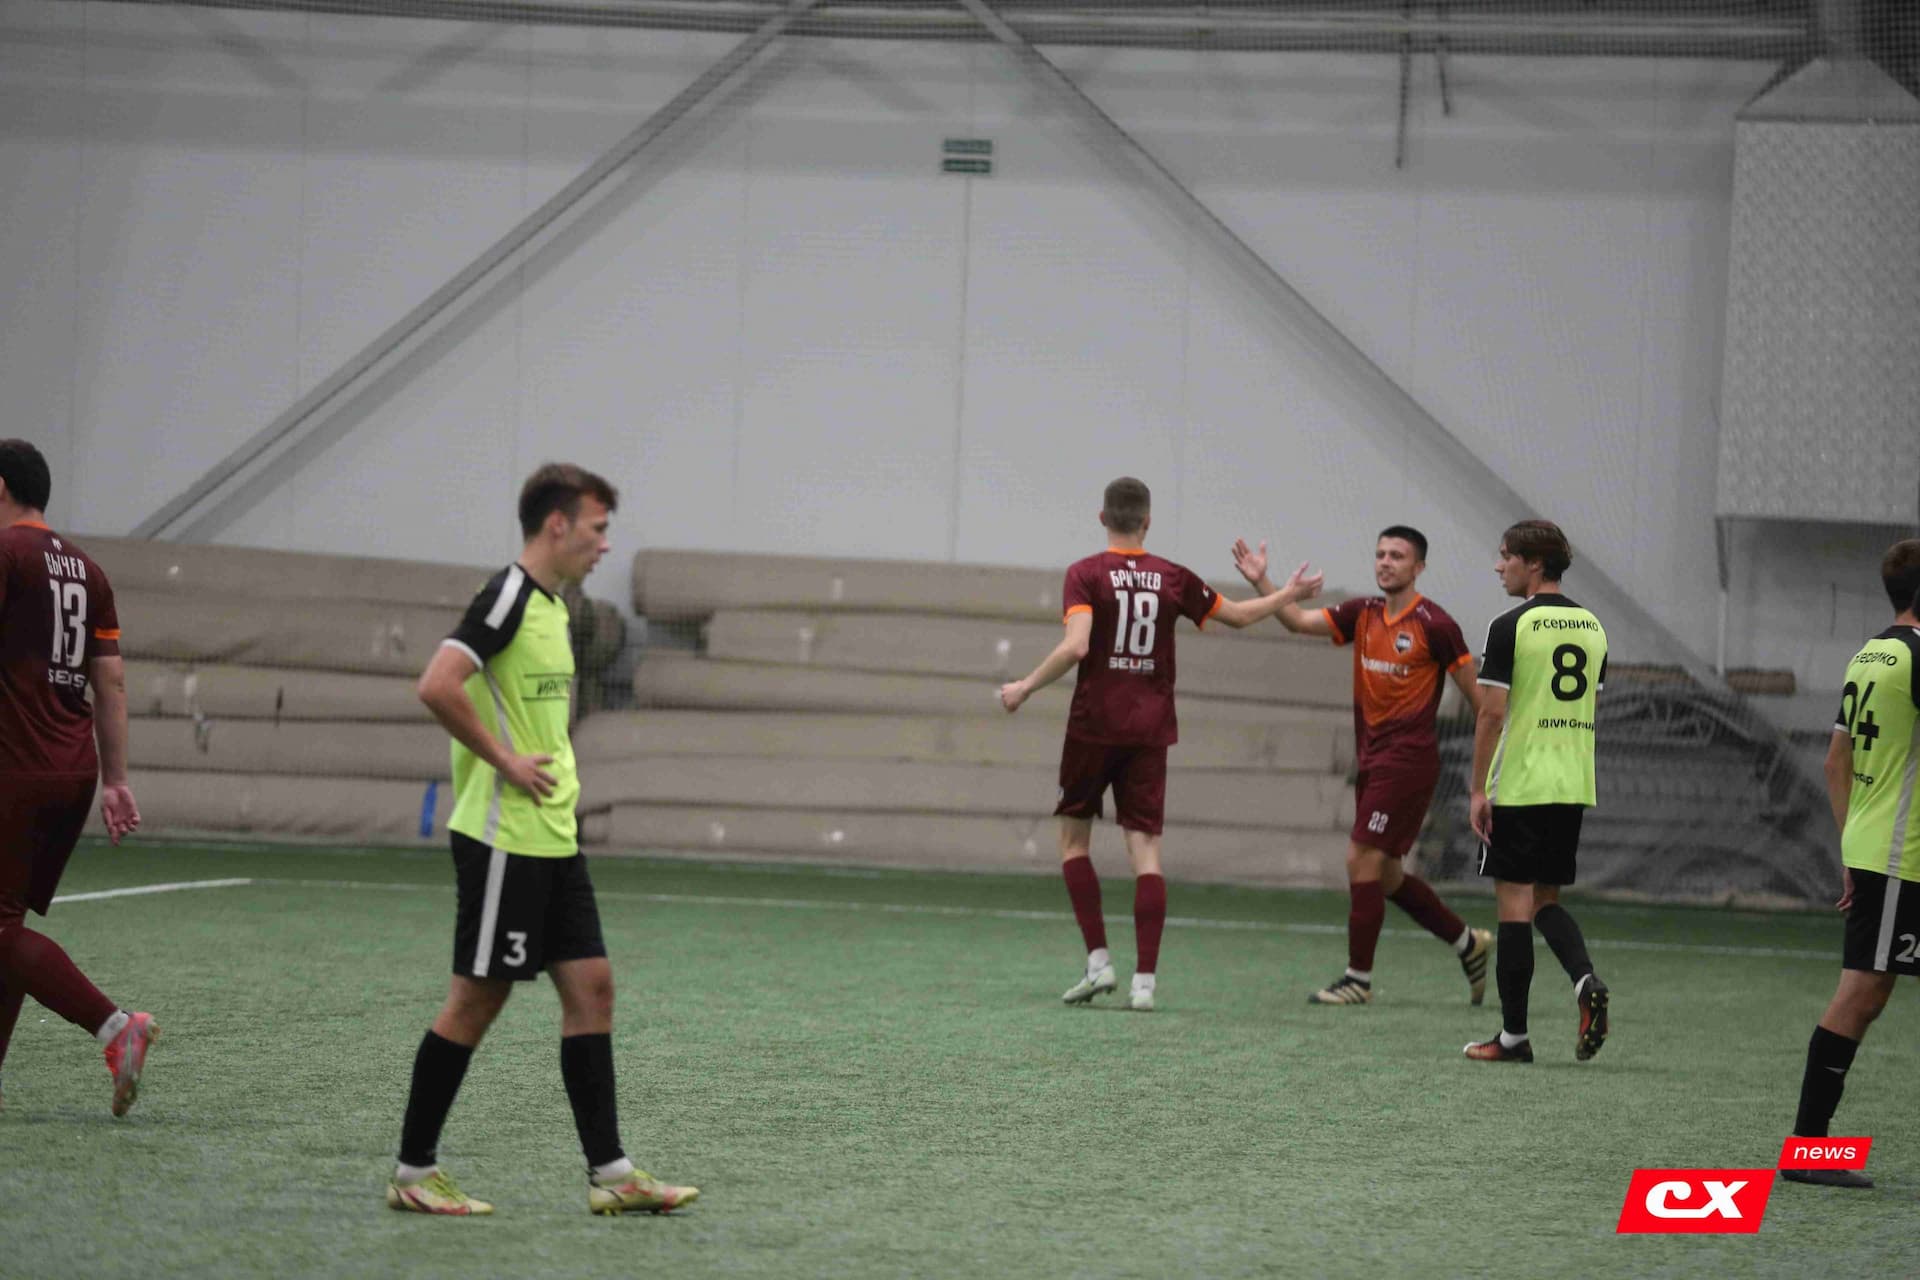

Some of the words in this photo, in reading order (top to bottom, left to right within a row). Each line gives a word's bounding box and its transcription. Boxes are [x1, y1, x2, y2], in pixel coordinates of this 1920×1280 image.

[49, 578, 88, 668] 13
[1114, 590, 1160, 656] 18
[1109, 656, 1155, 671] SEUS
[1551, 643, 1588, 702] 8
[503, 931, 528, 967] 3
